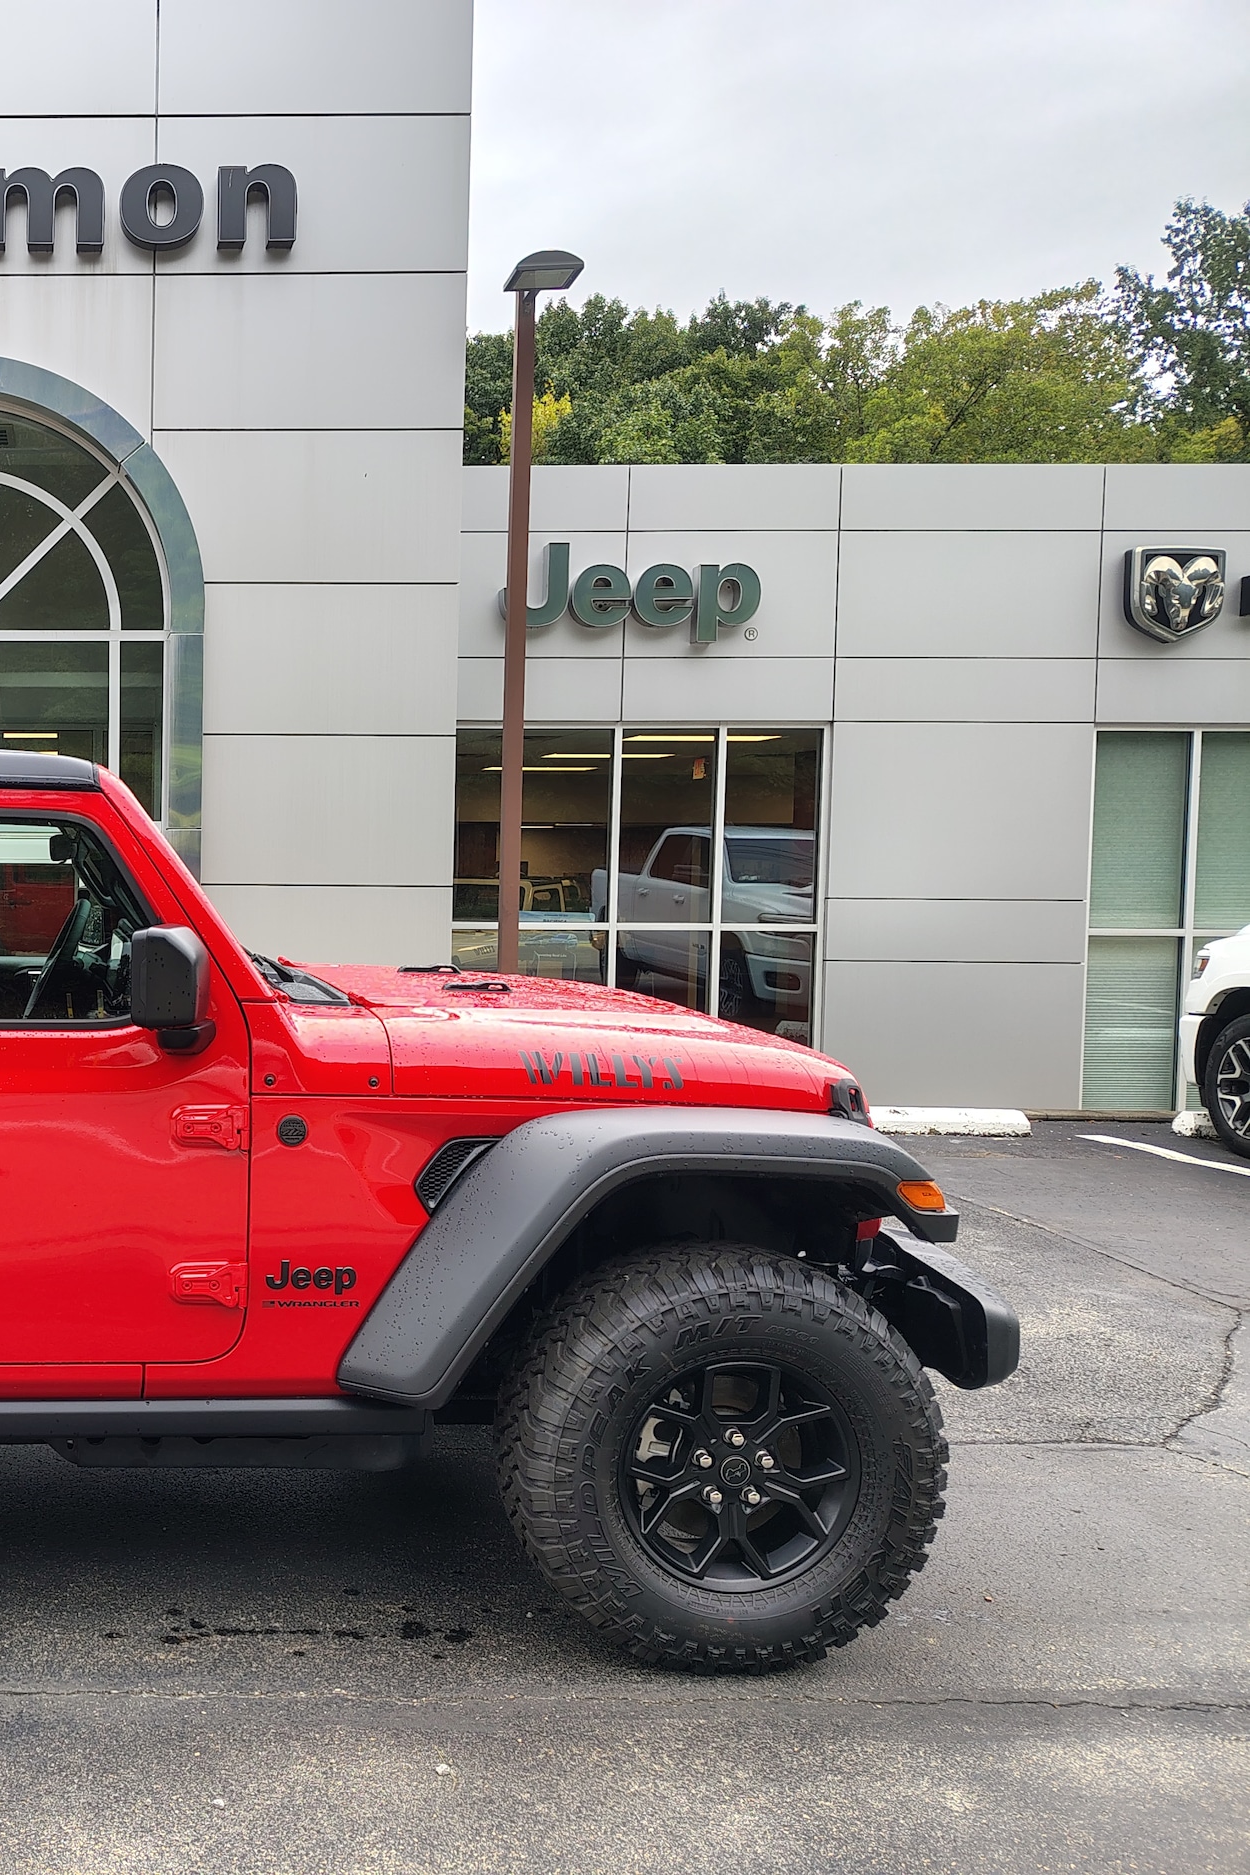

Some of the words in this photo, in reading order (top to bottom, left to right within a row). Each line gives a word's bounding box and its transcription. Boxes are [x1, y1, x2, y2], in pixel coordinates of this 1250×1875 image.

[498, 542, 761, 643] Jeep
[519, 1050, 683, 1089] WILLYS
[266, 1260, 356, 1295] Jeep
[578, 1352, 652, 1599] WILDPEAK
[674, 1315, 763, 1351] M/T
